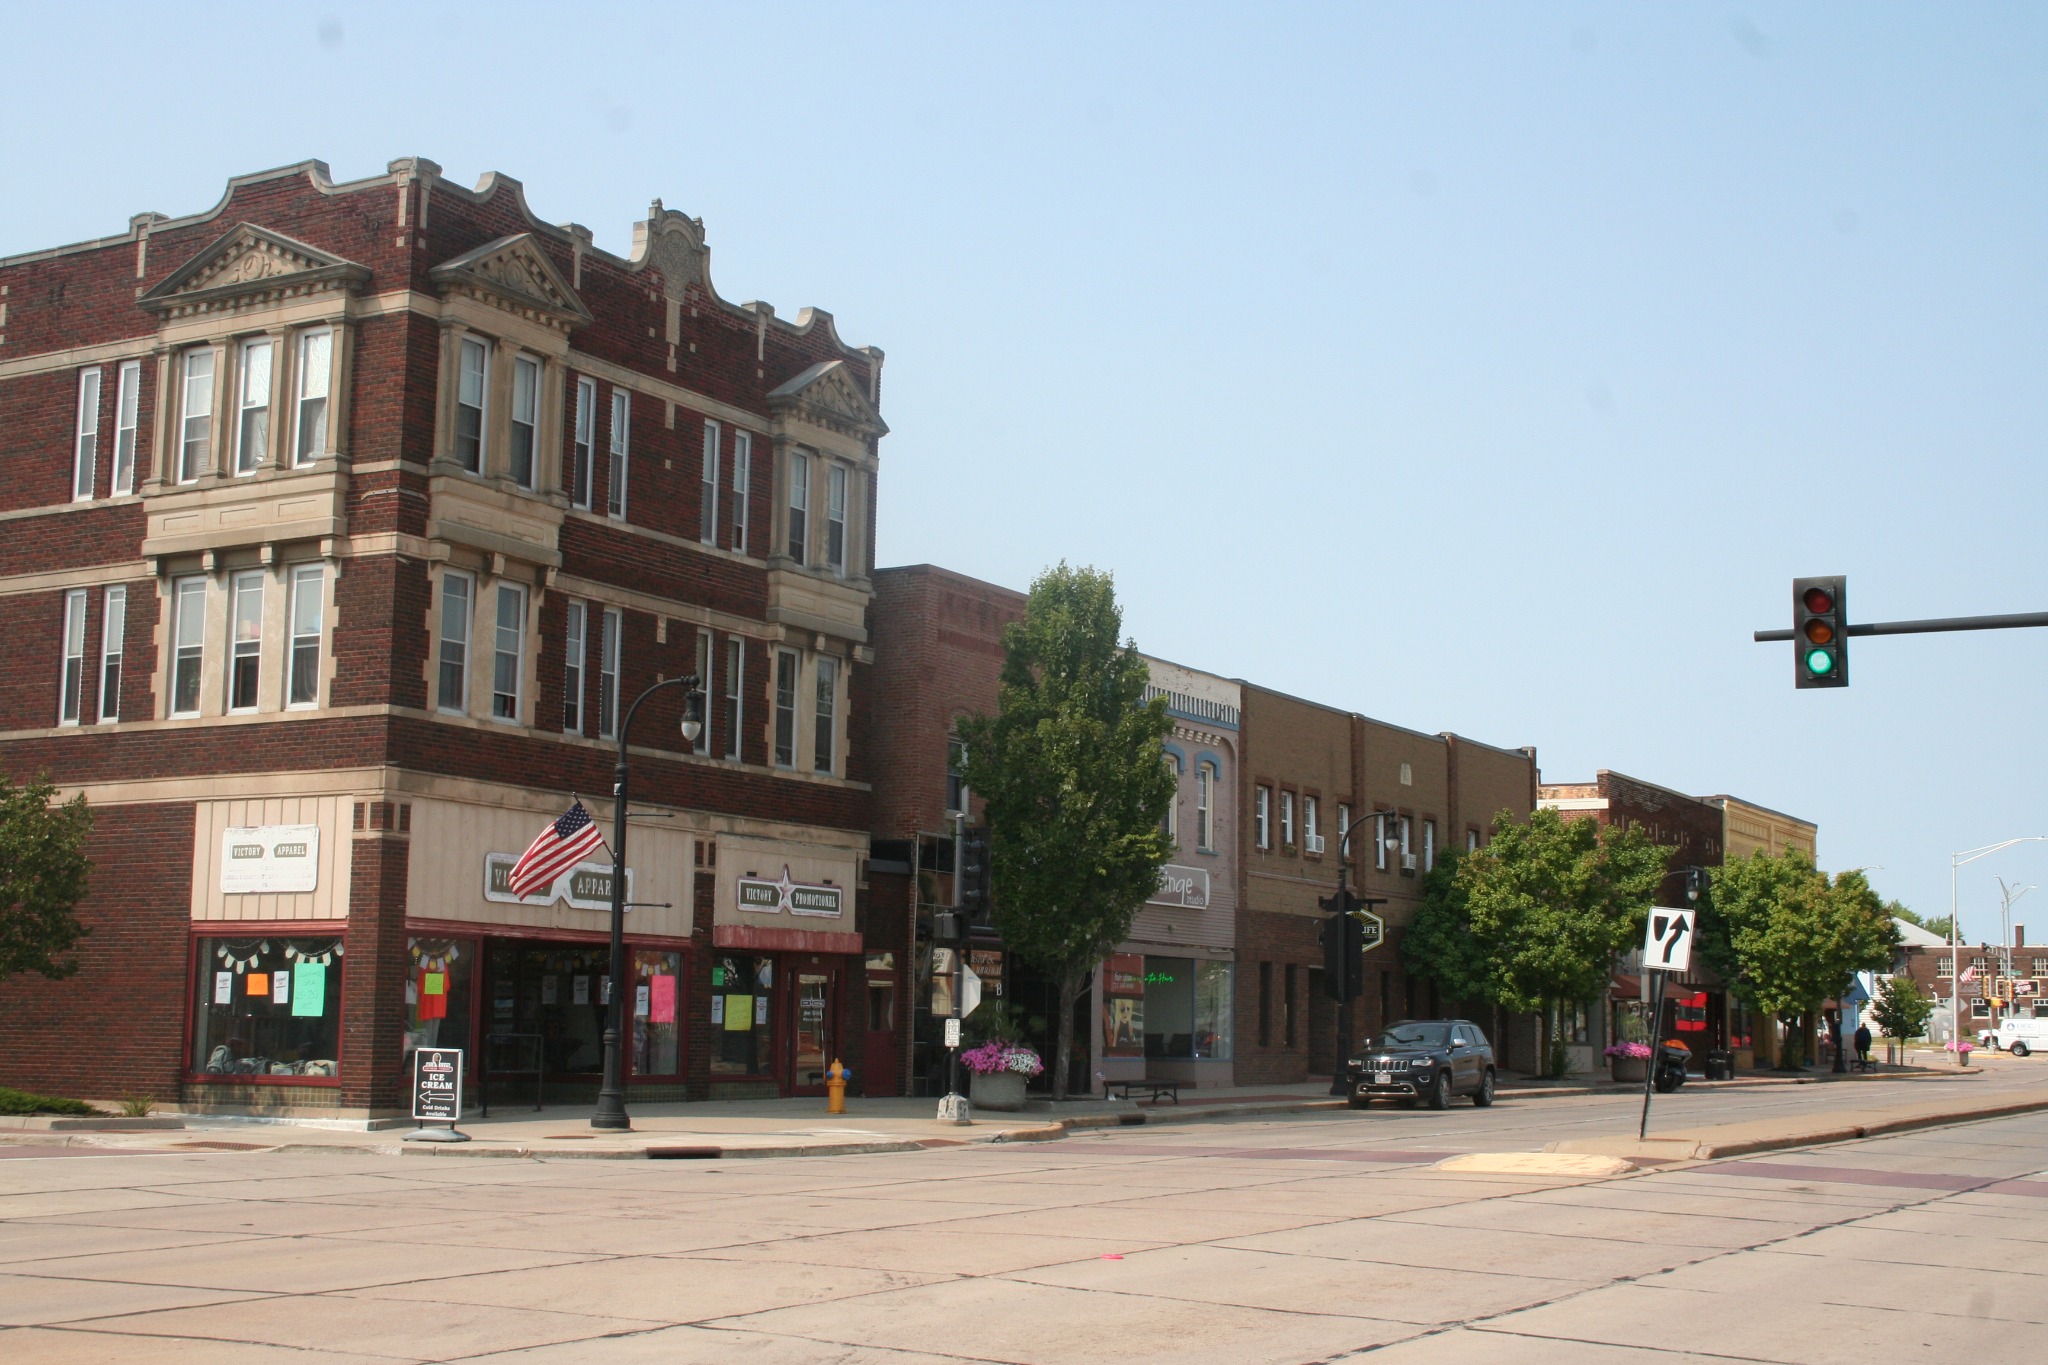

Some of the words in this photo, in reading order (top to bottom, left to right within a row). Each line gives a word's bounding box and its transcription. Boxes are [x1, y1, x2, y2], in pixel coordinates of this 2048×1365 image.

[233, 846, 261, 857] VICTORY
[276, 845, 306, 856] APPAREL
[576, 877, 612, 896] APPAR
[745, 887, 772, 902] VICTORY
[795, 892, 836, 908] PROMOTIONAL
[421, 1081, 453, 1089] CREAM
